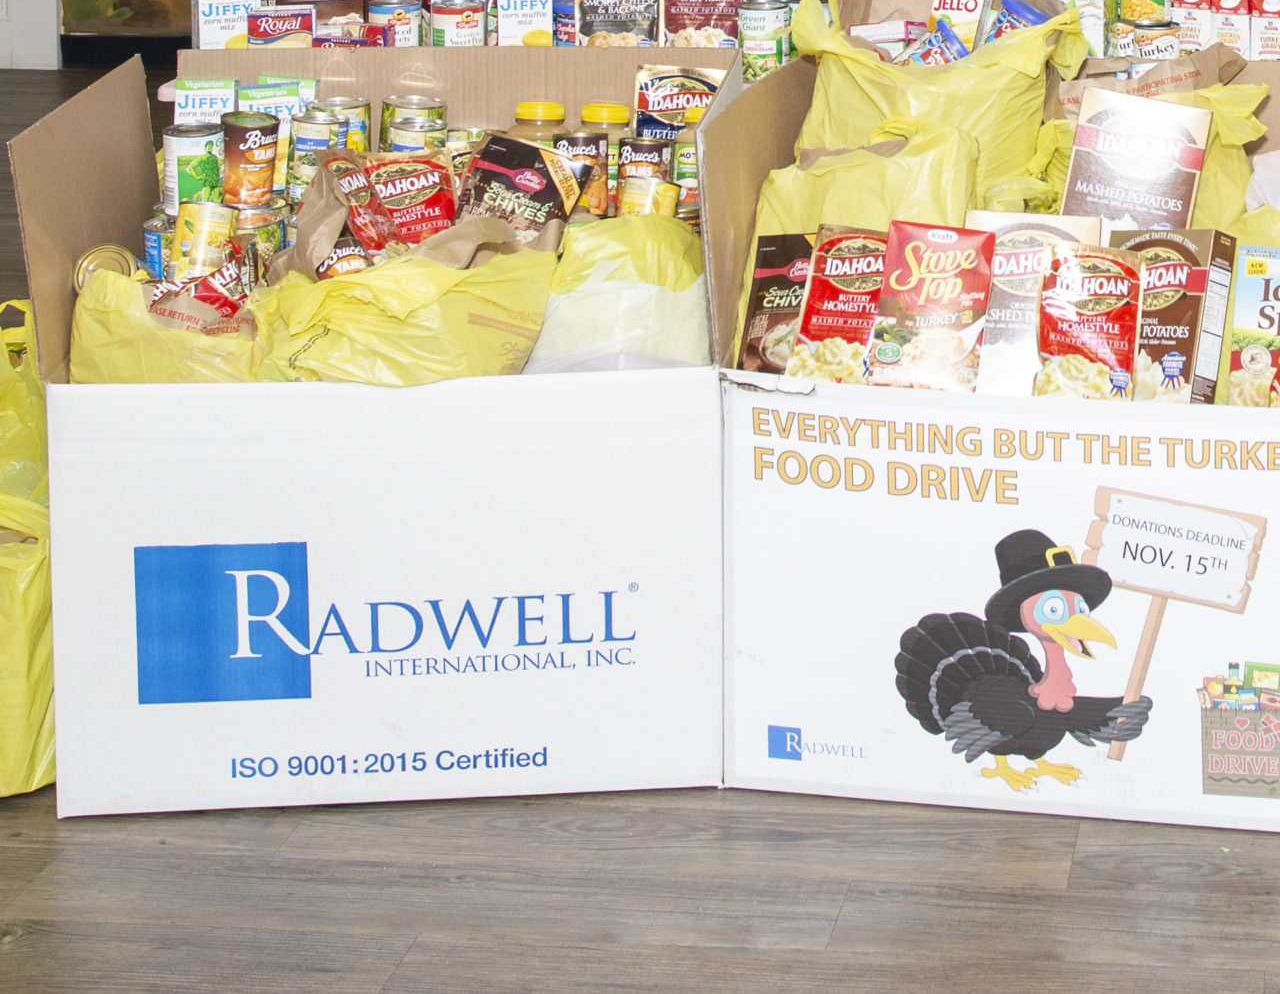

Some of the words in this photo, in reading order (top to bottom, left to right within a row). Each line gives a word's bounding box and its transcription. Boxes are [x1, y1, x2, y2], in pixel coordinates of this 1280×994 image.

[202, 3, 251, 18] JIFFY
[607, 5, 640, 14] BACON
[740, 12, 766, 23] Green
[257, 17, 301, 34] Royal
[742, 21, 766, 32] Giant
[1137, 43, 1175, 58] Turkey
[185, 80, 224, 89] Vegetarian
[177, 94, 230, 109] JIFFY
[252, 147, 277, 160] YAMS
[557, 139, 598, 155] Bruce's
[620, 144, 660, 164] Bruce's
[625, 164, 653, 177] YAMS
[1075, 181, 1125, 203] MASHED
[1126, 190, 1184, 212] POTATOES
[393, 204, 426, 218] BUTTERY
[483, 192, 547, 222] CHIVES
[931, 231, 954, 241] Kraft
[333, 259, 367, 274] YAMS
[889, 240, 978, 291] Stove
[917, 277, 963, 305] Top
[1055, 276, 1130, 296] IDAHOAN
[838, 293, 872, 303] BUTTERY
[167, 309, 200, 324] RETURN
[914, 314, 960, 328] TURKEY
[1057, 321, 1121, 335] HOMESTYLE
[1142, 325, 1190, 339] POTATOES
[752, 407, 983, 457] EVERYTHING
[993, 427, 1070, 462] BUT
[1076, 432, 1153, 466] THE
[753, 446, 875, 493] FOOD
[887, 461, 1020, 506] DRIVE
[1112, 513, 1184, 539] DONATIONS
[1185, 528, 1247, 551] DEADLINE
[1122, 540, 1175, 570] NOV.
[1184, 554, 1229, 576] 15TH
[225, 569, 638, 659] RADWELL
[364, 650, 578, 678] INTERNATIONAL,
[585, 647, 637, 668] INC.
[785, 731, 868, 759] RADWELL
[1211, 730, 1276, 751] FOOD
[230, 757, 279, 779] ISO
[287, 752, 427, 777] 9001:2015
[434, 747, 549, 772] Certified
[1207, 753, 1280, 776] DRIVE
